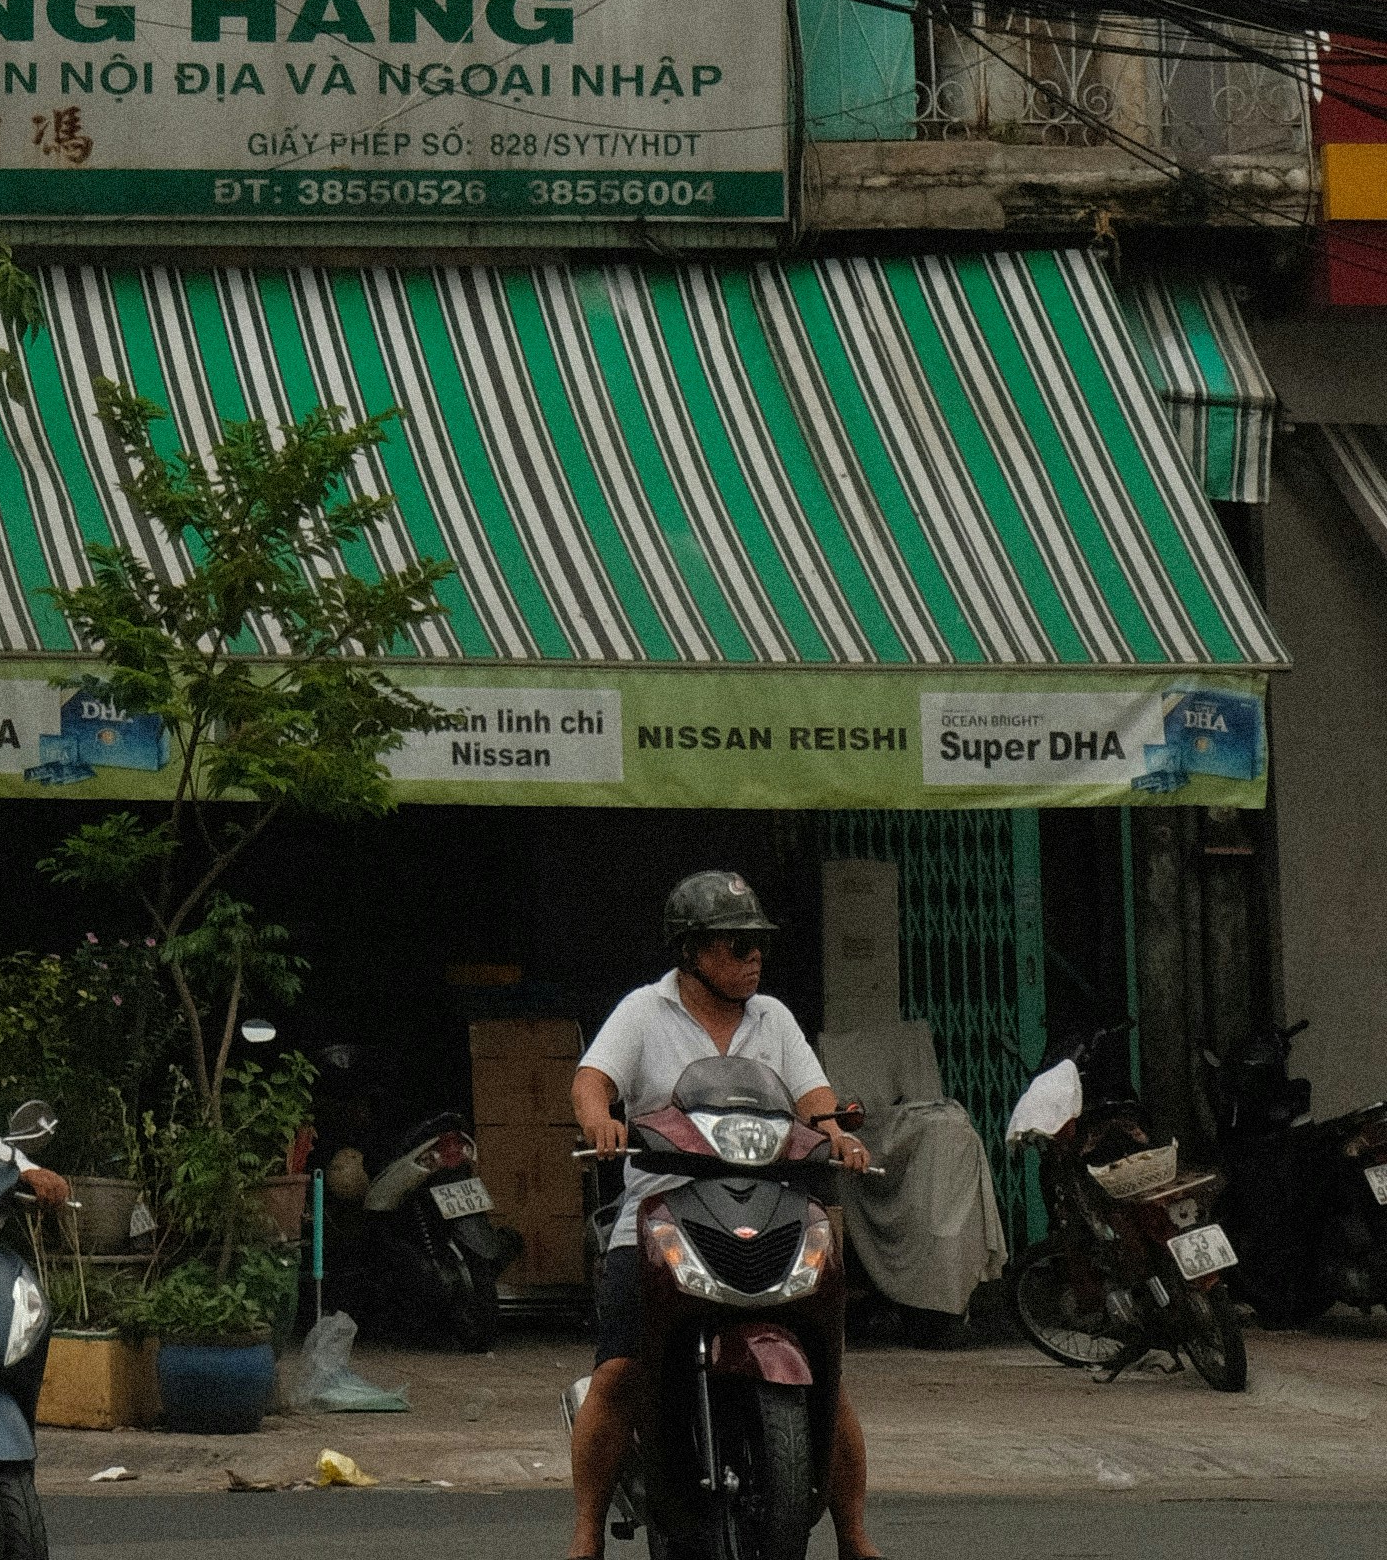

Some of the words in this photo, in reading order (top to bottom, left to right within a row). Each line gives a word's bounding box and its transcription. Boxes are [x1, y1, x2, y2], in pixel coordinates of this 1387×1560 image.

[61, 53, 153, 102] NỘI
[175, 62, 265, 102] ĐỊA
[286, 55, 356, 95] VÀ
[379, 64, 551, 102] NGOẠI
[573, 56, 722, 104] NHẬP
[330, 126, 411, 157] PHÉP
[422, 122, 472, 157] SỐ:
[213, 178, 283, 204] ĐT:
[298, 178, 486, 206] 38550526
[531, 178, 716, 206] 38556004
[497, 708, 551, 733] linh
[560, 708, 604, 734] chi
[941, 714, 989, 728] OCEAN
[1183, 710, 1230, 733] DHA
[637, 725, 773, 751] NISSAN
[788, 726, 909, 752] REISHI
[940, 731, 1041, 769] Super
[1049, 731, 1127, 762] DHA
[451, 741, 551, 767] Nissan
